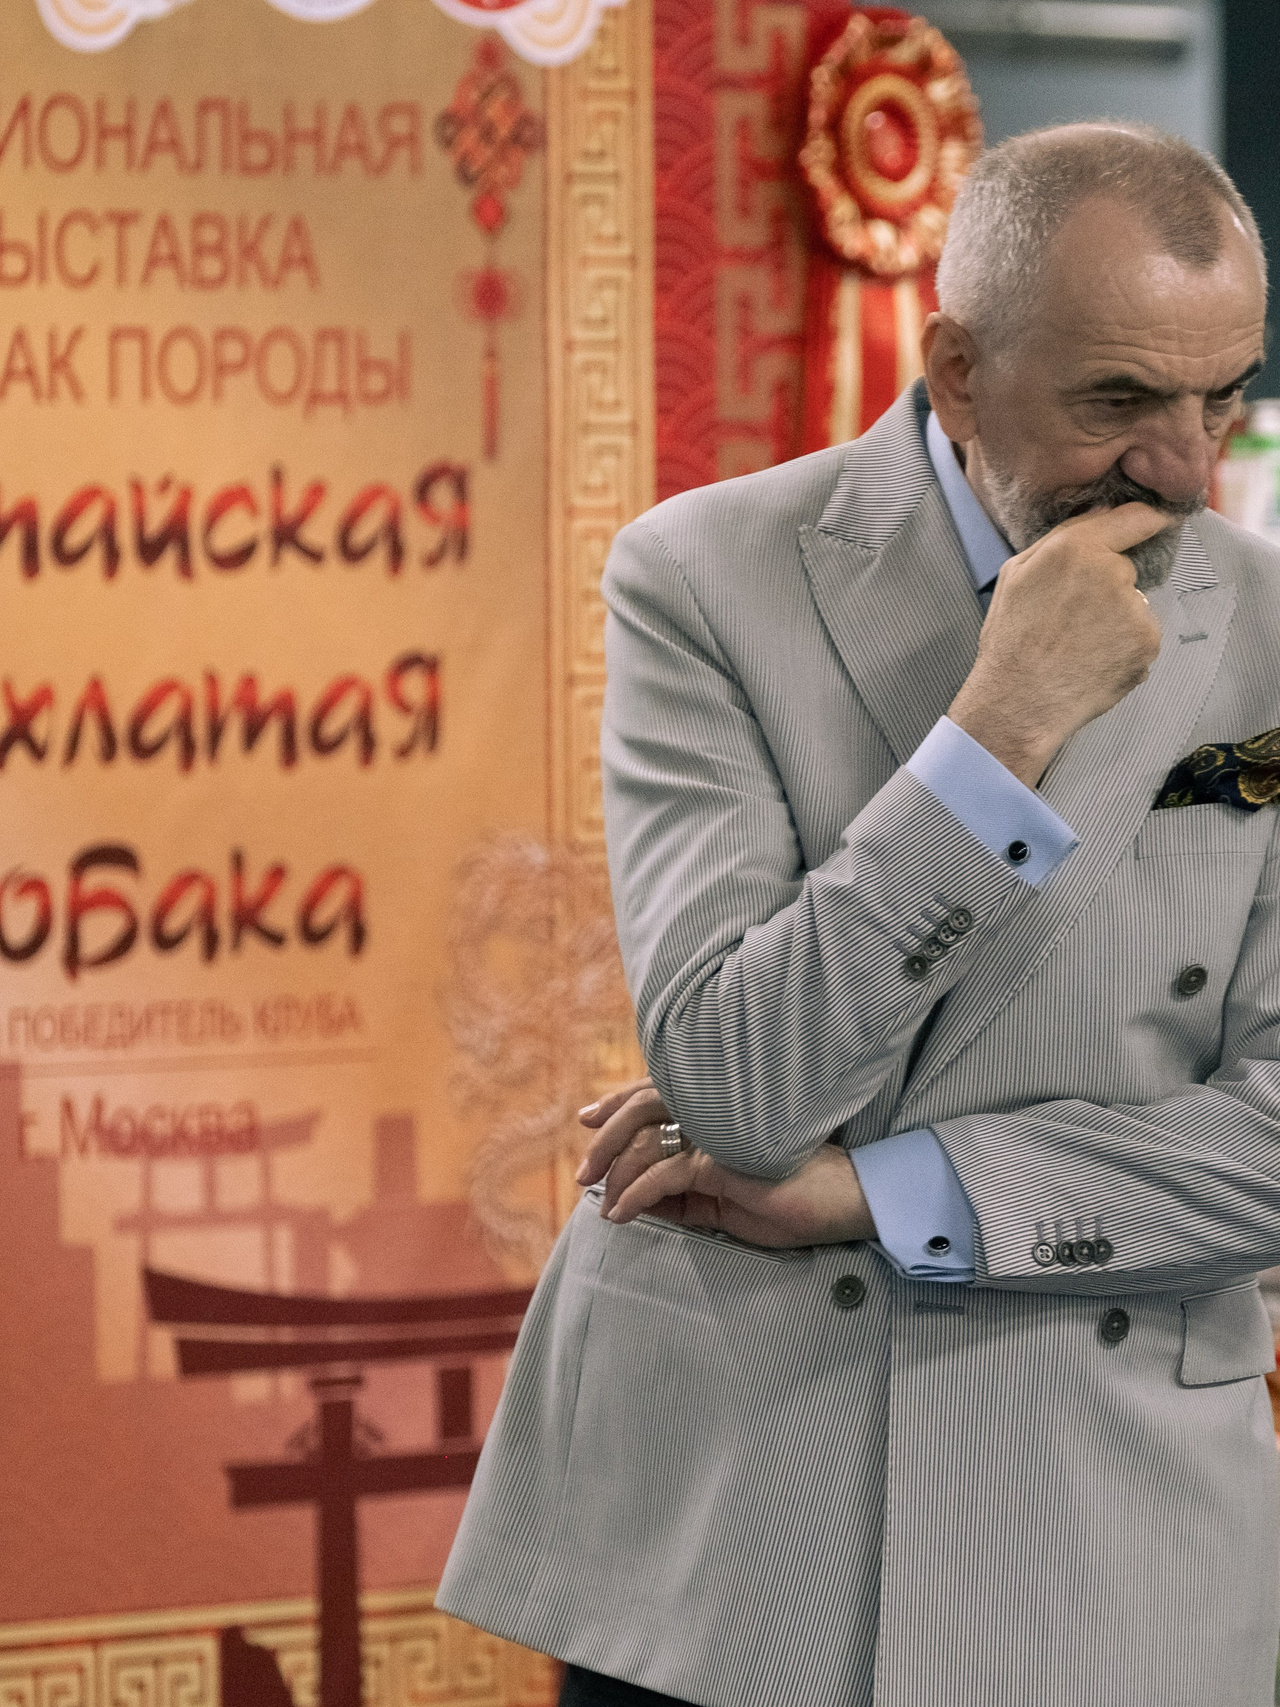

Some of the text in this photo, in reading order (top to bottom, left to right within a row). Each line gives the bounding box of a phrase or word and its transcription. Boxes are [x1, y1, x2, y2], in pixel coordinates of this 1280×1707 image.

[0, 207, 321, 292] ЫСТАВКА
[0, 323, 413, 424] АК ПОРОДЫ
